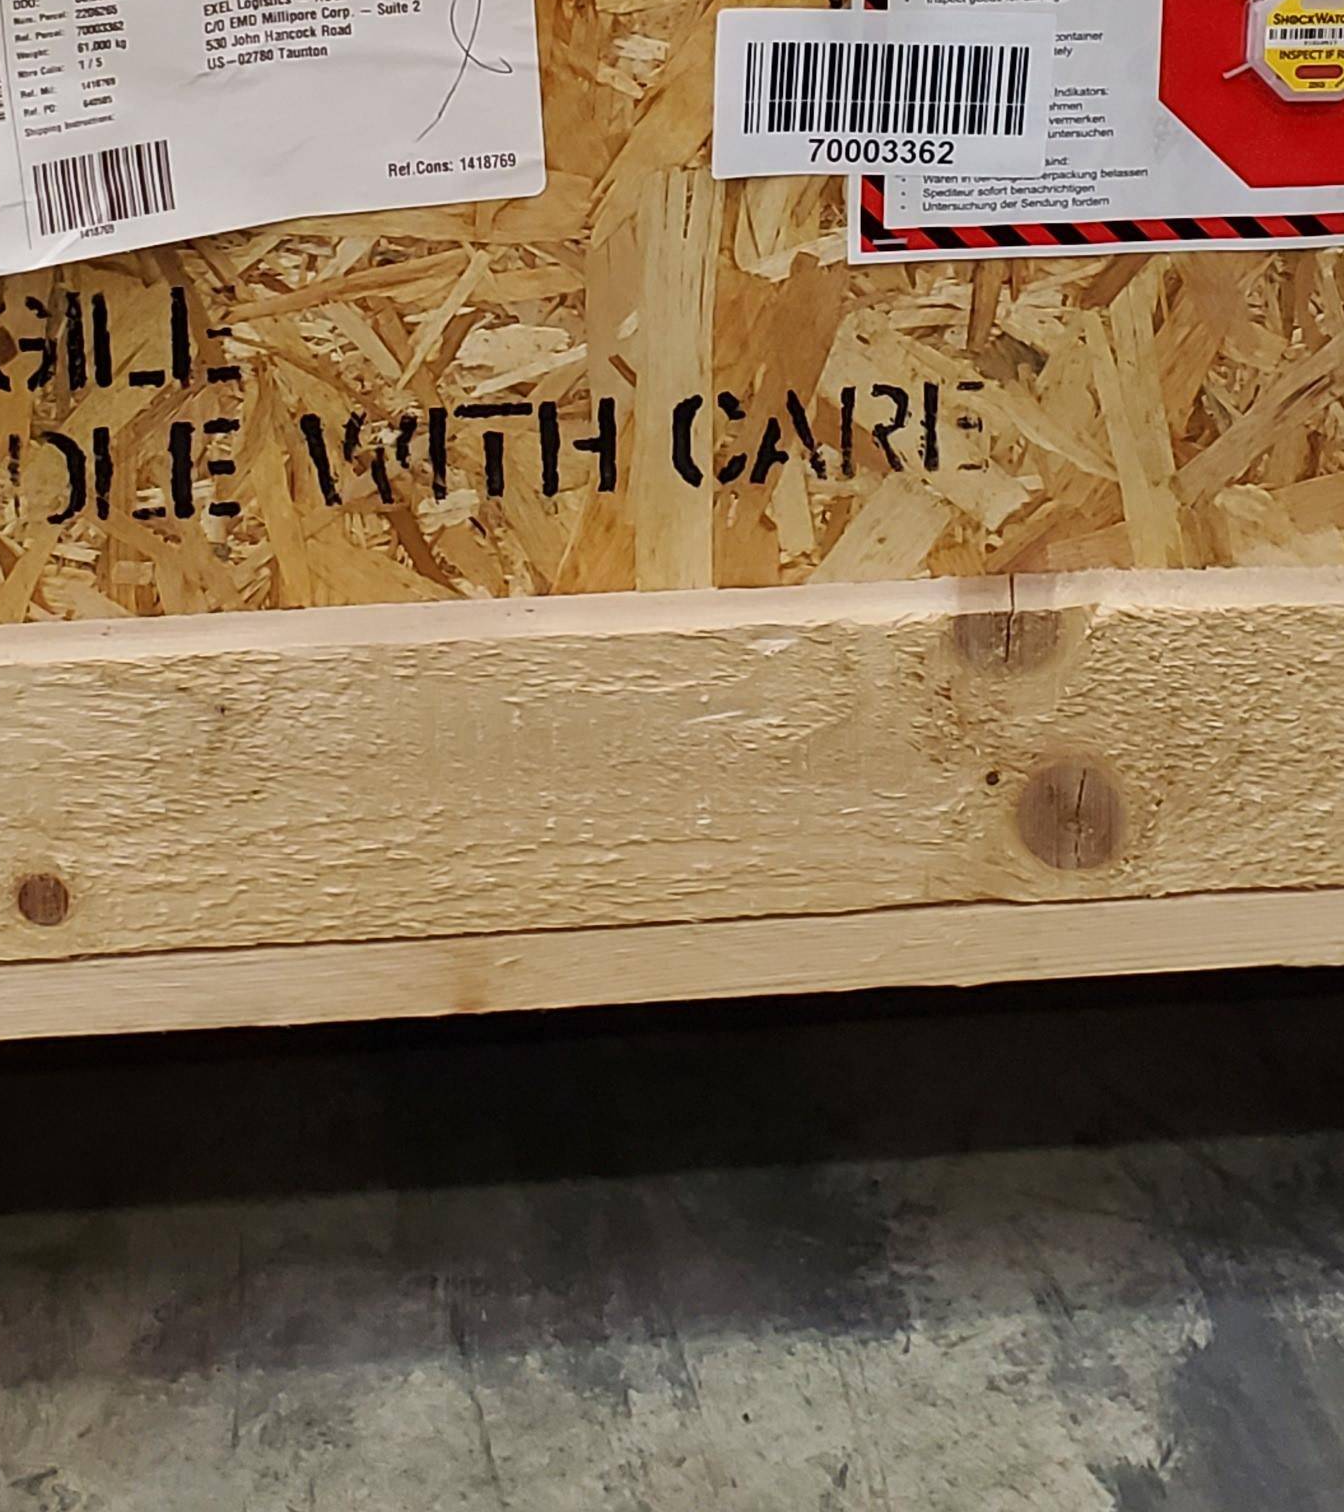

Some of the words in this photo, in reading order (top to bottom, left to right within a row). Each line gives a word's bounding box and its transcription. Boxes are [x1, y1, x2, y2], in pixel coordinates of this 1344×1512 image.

[204, 1, 233, 17] EXEL
[205, 20, 225, 34] C/O
[230, 15, 256, 29] EMD
[262, 8, 317, 25] Millipore
[377, 2, 408, 16] Suite
[412, 0, 421, 12] 2
[116, 39, 126, 50] kg
[206, 37, 227, 52] 530
[231, 33, 260, 48] John
[265, 26, 316, 42] Hancock
[321, 23, 352, 37] Road
[278, 45, 328, 59] Taunton
[1279, 50, 1323, 60] INSPECT
[1325, 50, 1334, 59] IF
[808, 138, 955, 165] 70003362
[459, 153, 516, 171] 1418769
[923, 175, 958, 185] Waren
[1101, 168, 1148, 178] belassen
[978, 186, 1008, 196] sofort
[1010, 185, 1095, 196] benachrichtigen
[922, 201, 997, 212] Untersuchung
[1000, 199, 1017, 209] der
[1021, 198, 1069, 209] Sendung
[299, 396, 617, 506] WITH
[672, 381, 986, 488] CARE
